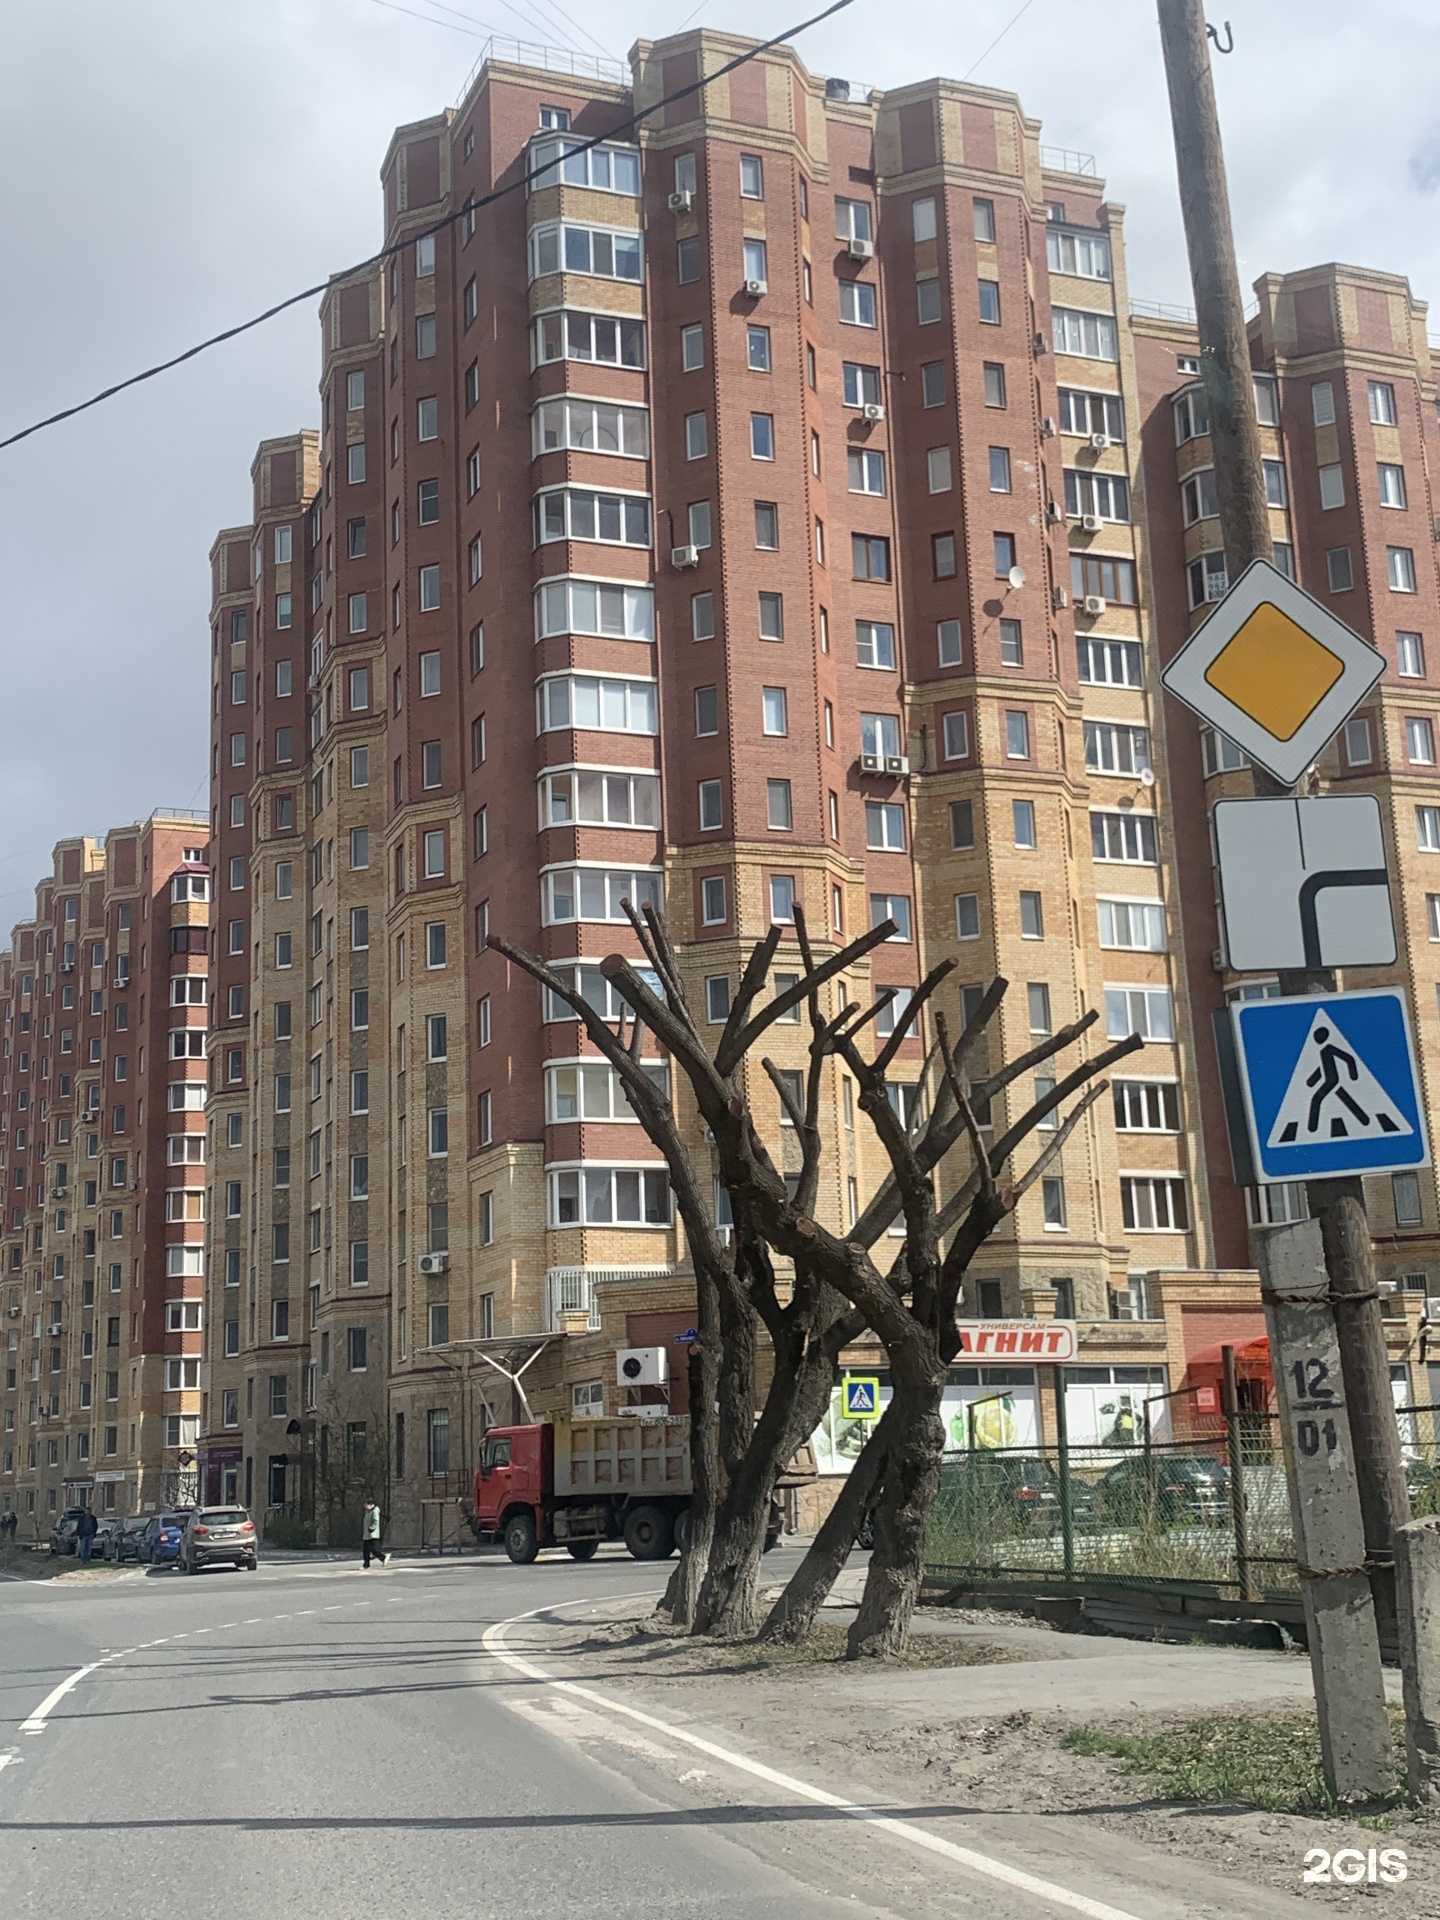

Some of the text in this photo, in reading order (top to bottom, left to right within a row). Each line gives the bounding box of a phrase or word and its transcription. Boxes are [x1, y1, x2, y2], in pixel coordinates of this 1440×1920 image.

[979, 1322, 1047, 1330] УНИВЕРСАМ
[1289, 1358, 1335, 1399] 12
[1297, 1418, 1337, 1457] 01
